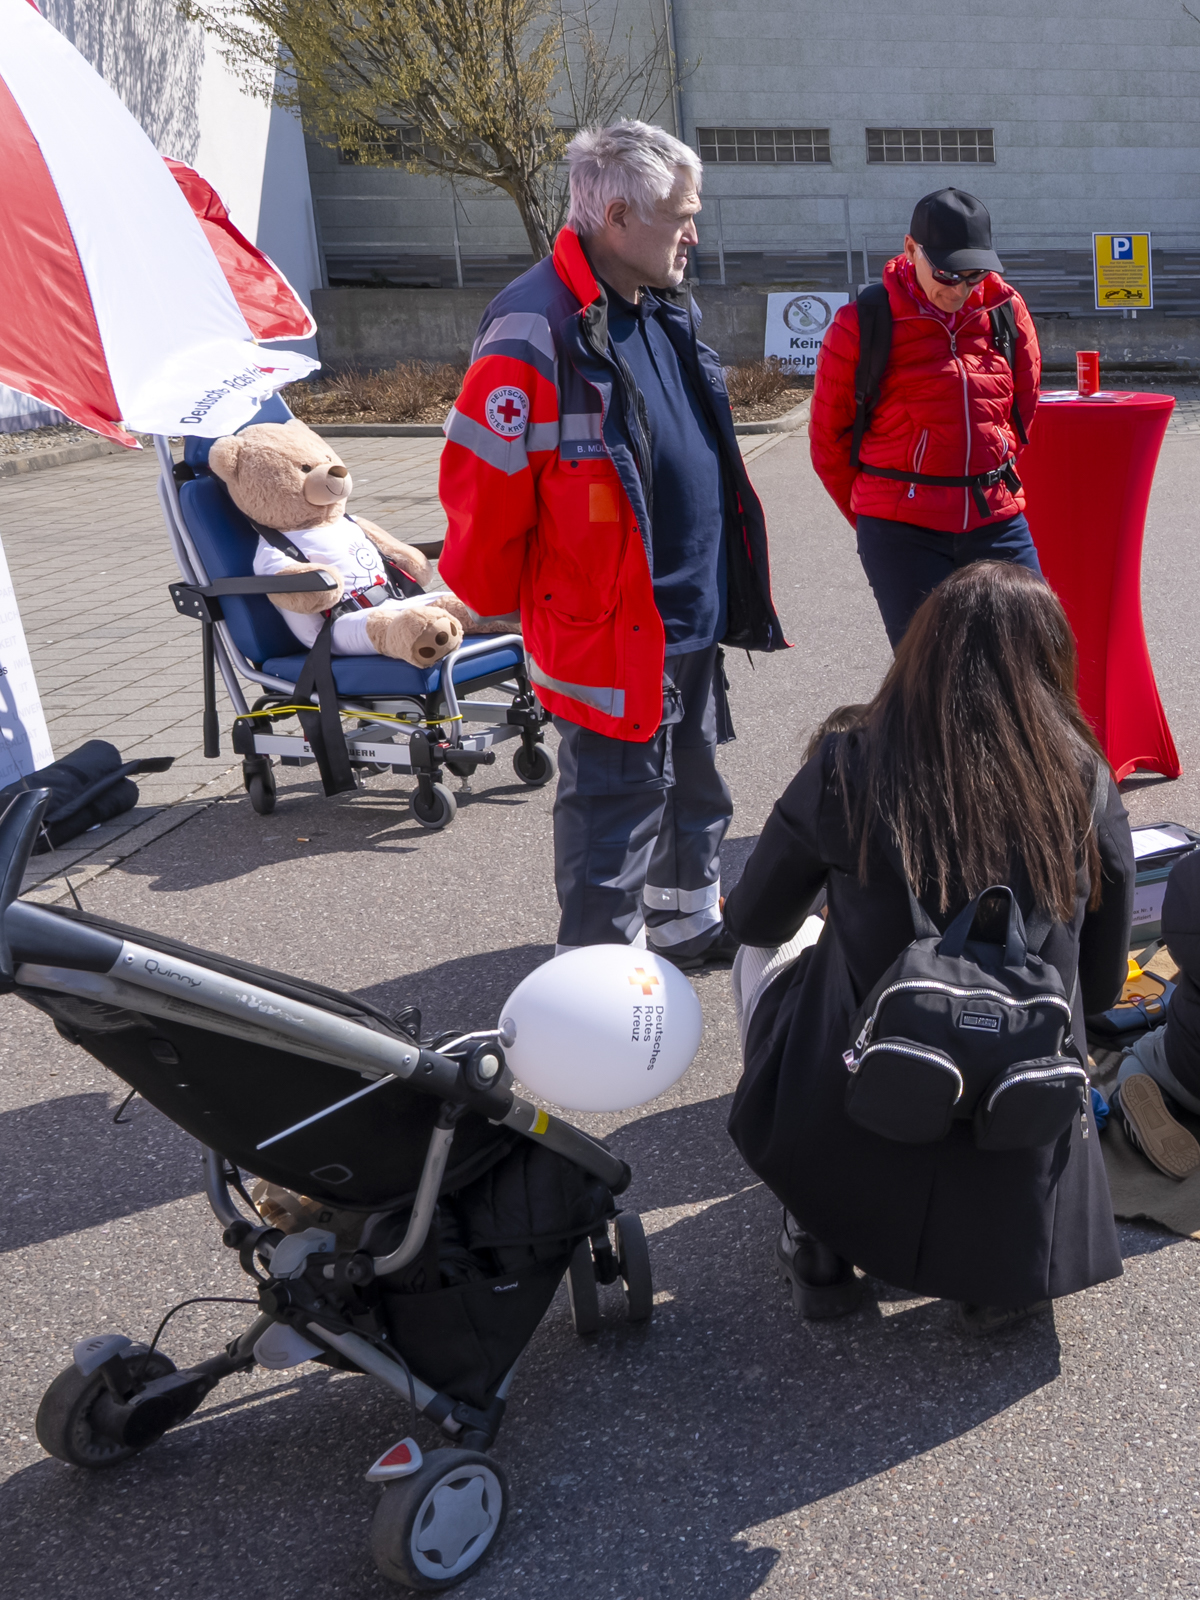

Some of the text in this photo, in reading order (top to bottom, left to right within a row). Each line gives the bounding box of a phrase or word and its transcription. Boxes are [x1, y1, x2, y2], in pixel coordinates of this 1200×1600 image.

[1113, 237, 1130, 259] P
[790, 337, 823, 349] Kein
[490, 389, 527, 410] DEUTSCHES
[489, 408, 506, 432] ROTES
[577, 445, 586, 453] B.
[144, 958, 202, 988] Quinny
[631, 1005, 643, 1042] Kreuz
[643, 1005, 654, 1042] Rotes
[646, 1005, 664, 1071] Deutsches
